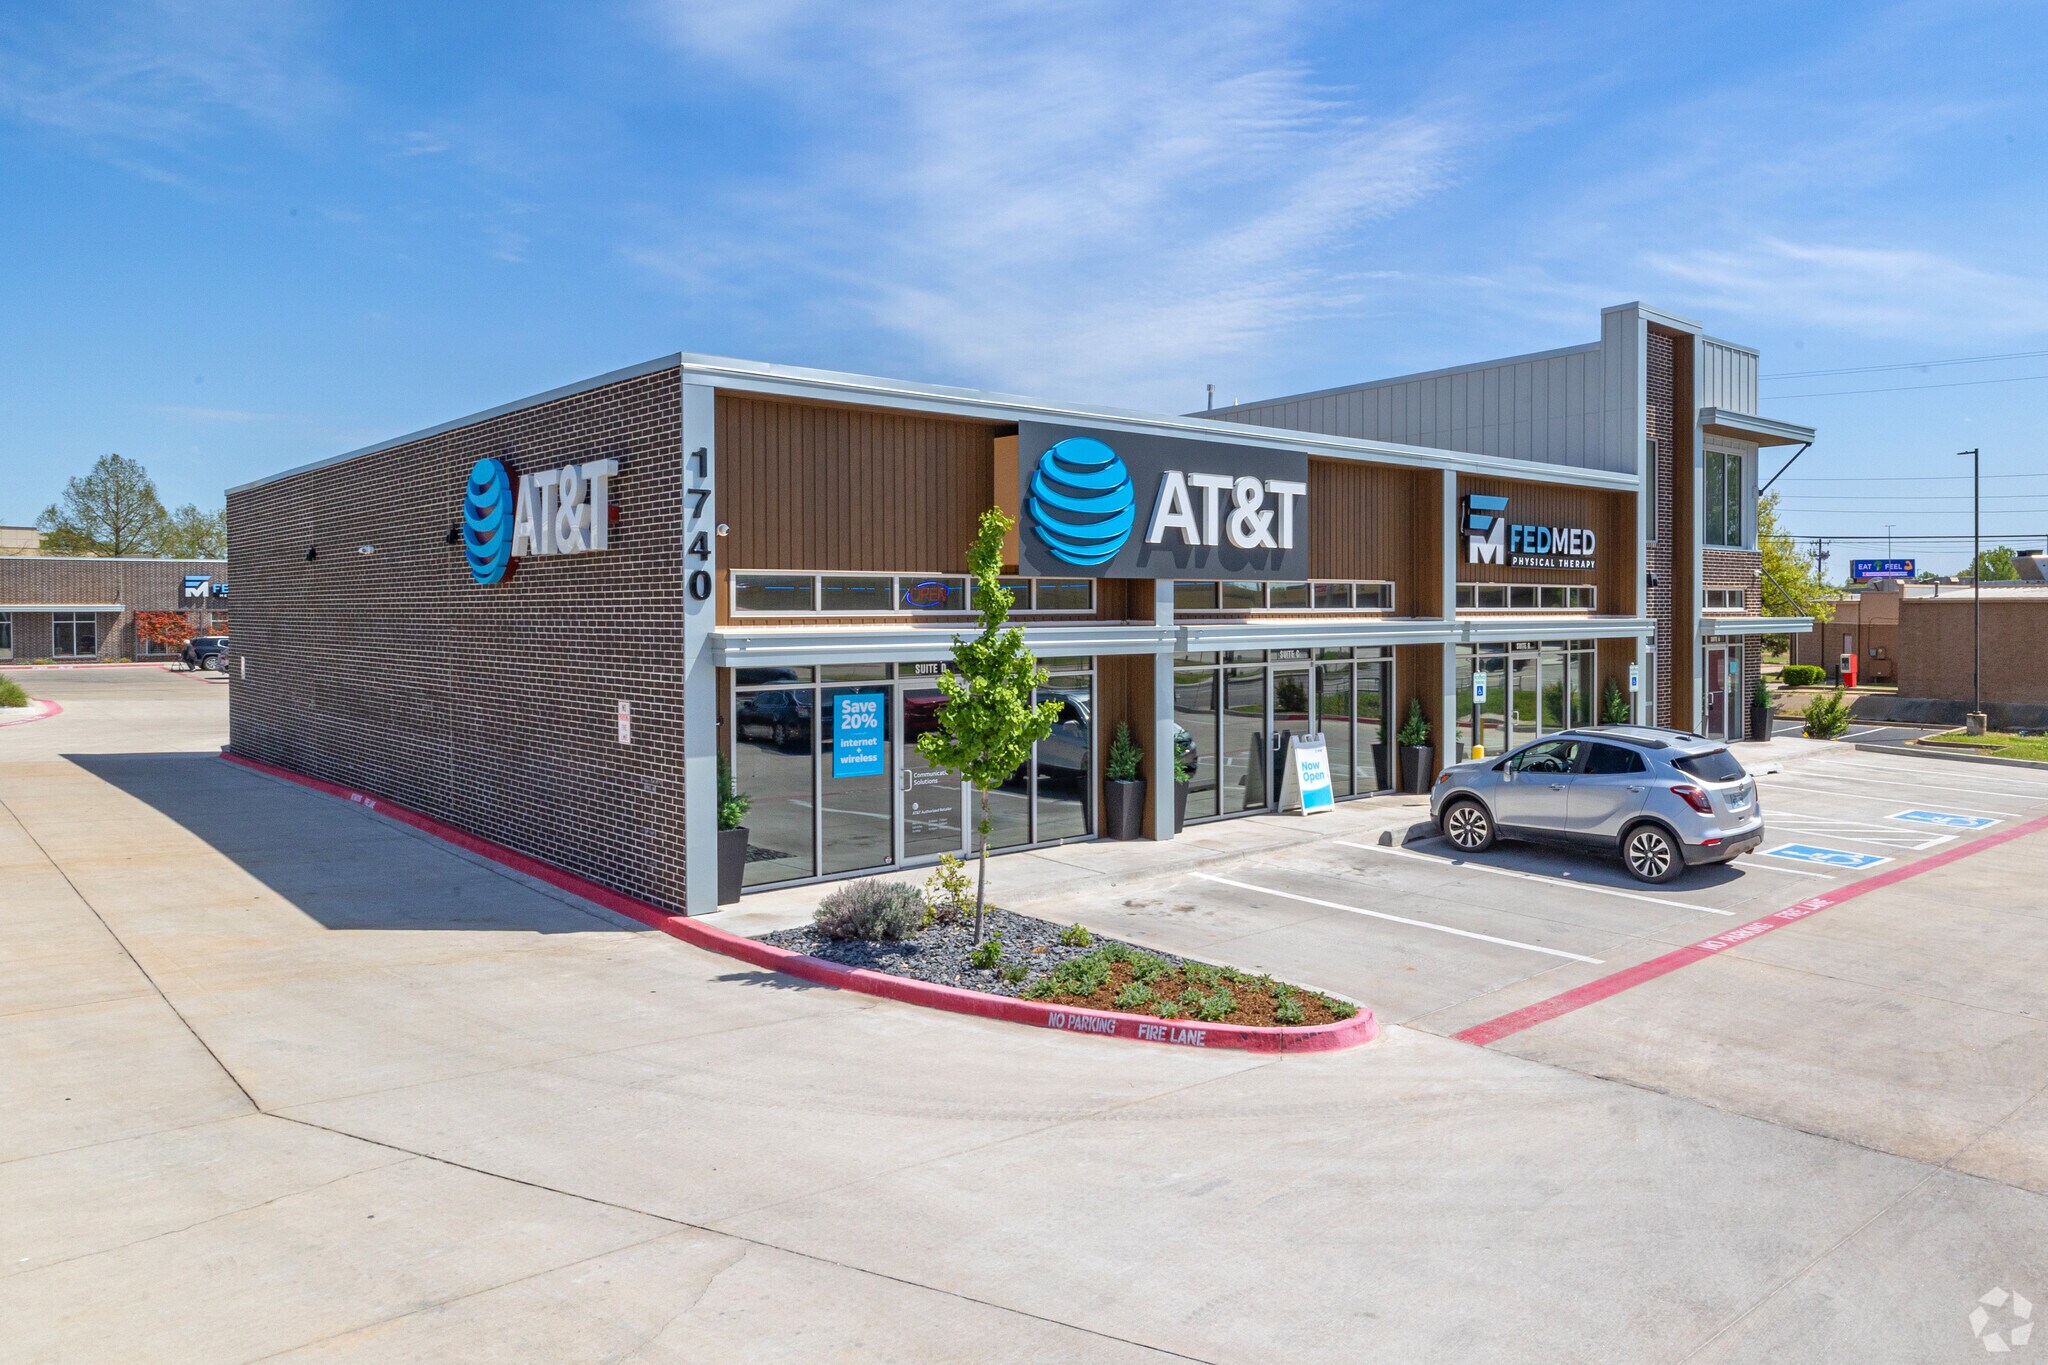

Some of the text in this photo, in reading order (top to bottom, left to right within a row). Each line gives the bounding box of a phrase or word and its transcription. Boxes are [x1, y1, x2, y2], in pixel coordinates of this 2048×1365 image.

[511, 459, 619, 557] AT&T
[1145, 470, 1307, 549] AT&T
[688, 448, 712, 601] 1740
[1510, 524, 1596, 555] FEDMED
[1512, 556, 1595, 569] PHYSICAL THERAPY
[910, 586, 947, 602] OPEN
[1280, 650, 1295, 659] SUITE
[915, 663, 938, 674] SUITE
[842, 700, 877, 714] Save
[841, 713, 878, 730] 20%
[840, 737, 877, 748] internet
[840, 753, 878, 764] wireless
[1302, 760, 1320, 771] Now
[1303, 771, 1325, 783] Open
[1718, 922, 1775, 943] PARKING
[1048, 1012, 1207, 1047] NO PARKING FIRE LANE
